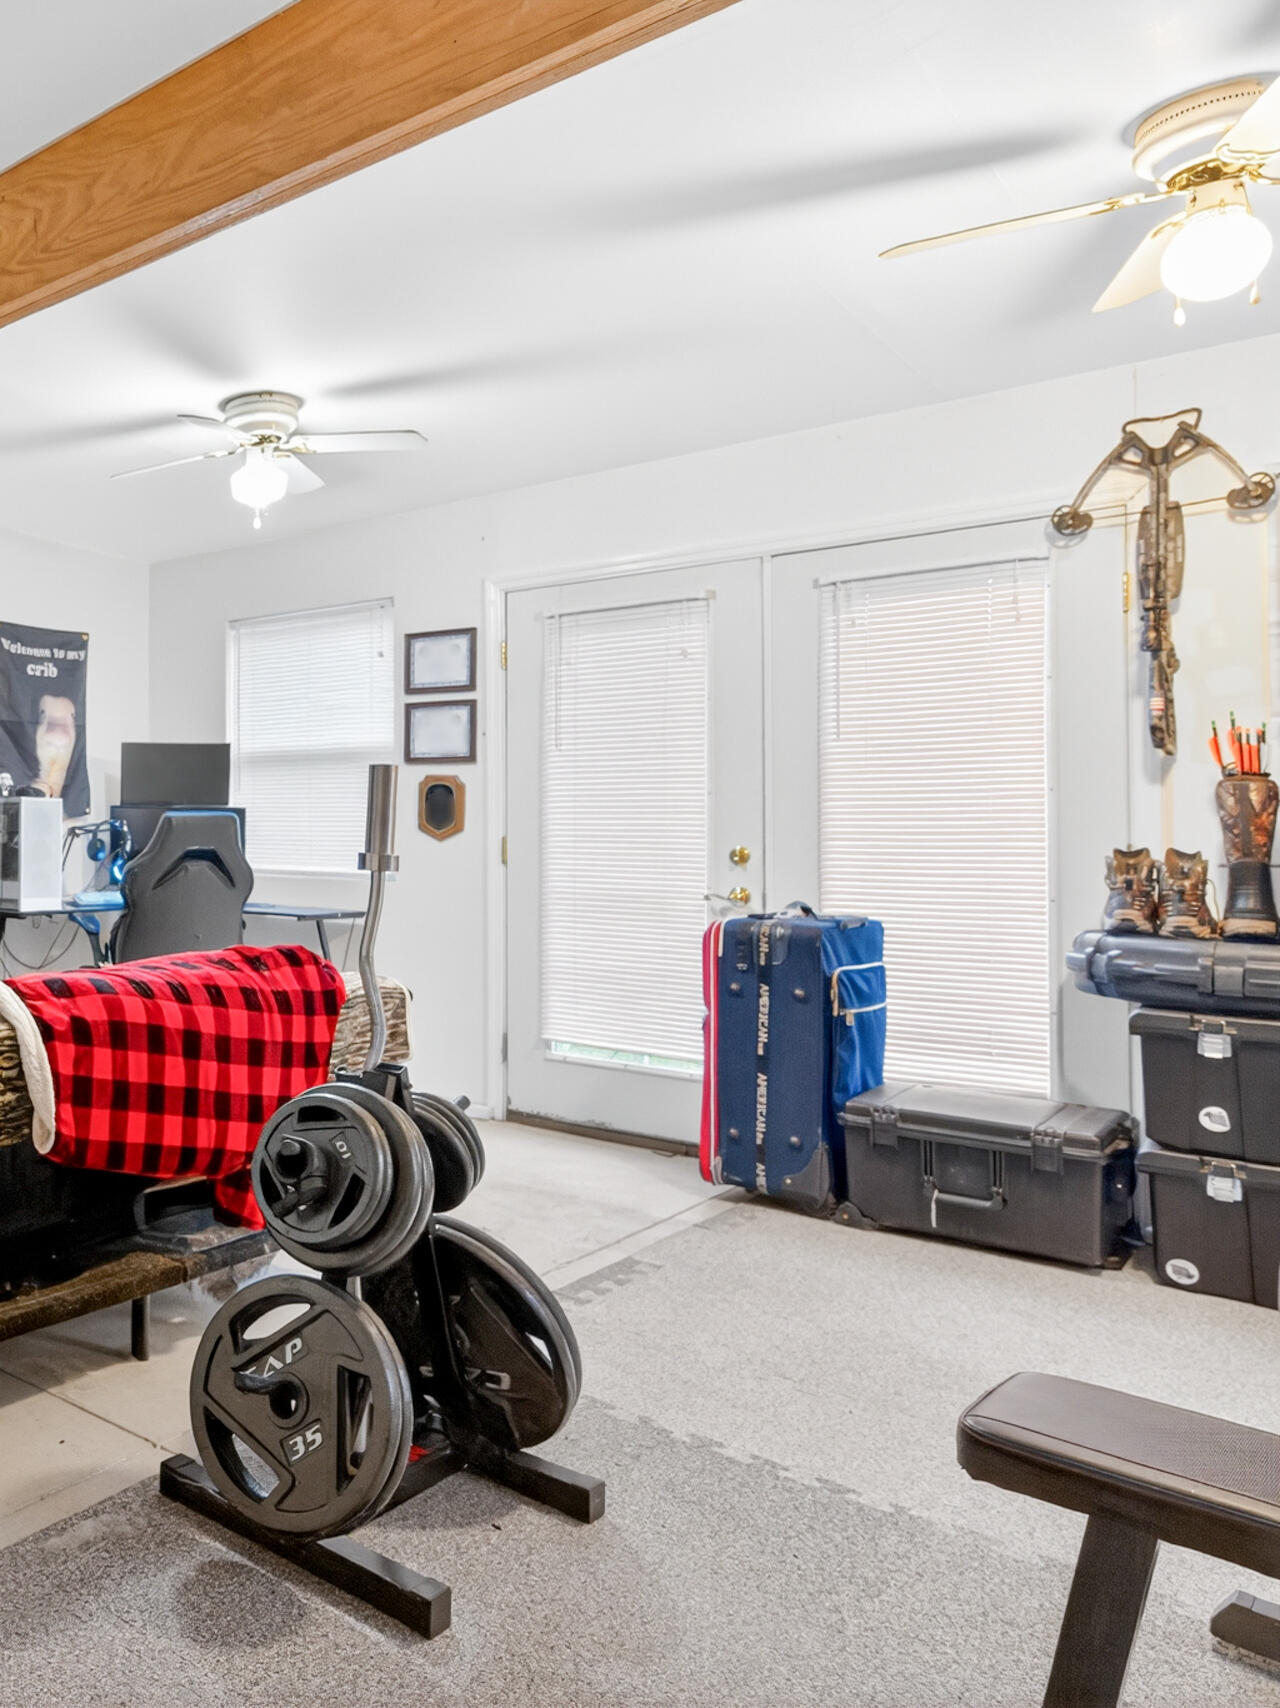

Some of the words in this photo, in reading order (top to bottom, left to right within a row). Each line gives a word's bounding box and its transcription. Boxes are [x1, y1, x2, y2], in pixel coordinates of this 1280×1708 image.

[66, 650, 86, 661] my
[26, 661, 58, 678] crib
[288, 1424, 323, 1461] 35
